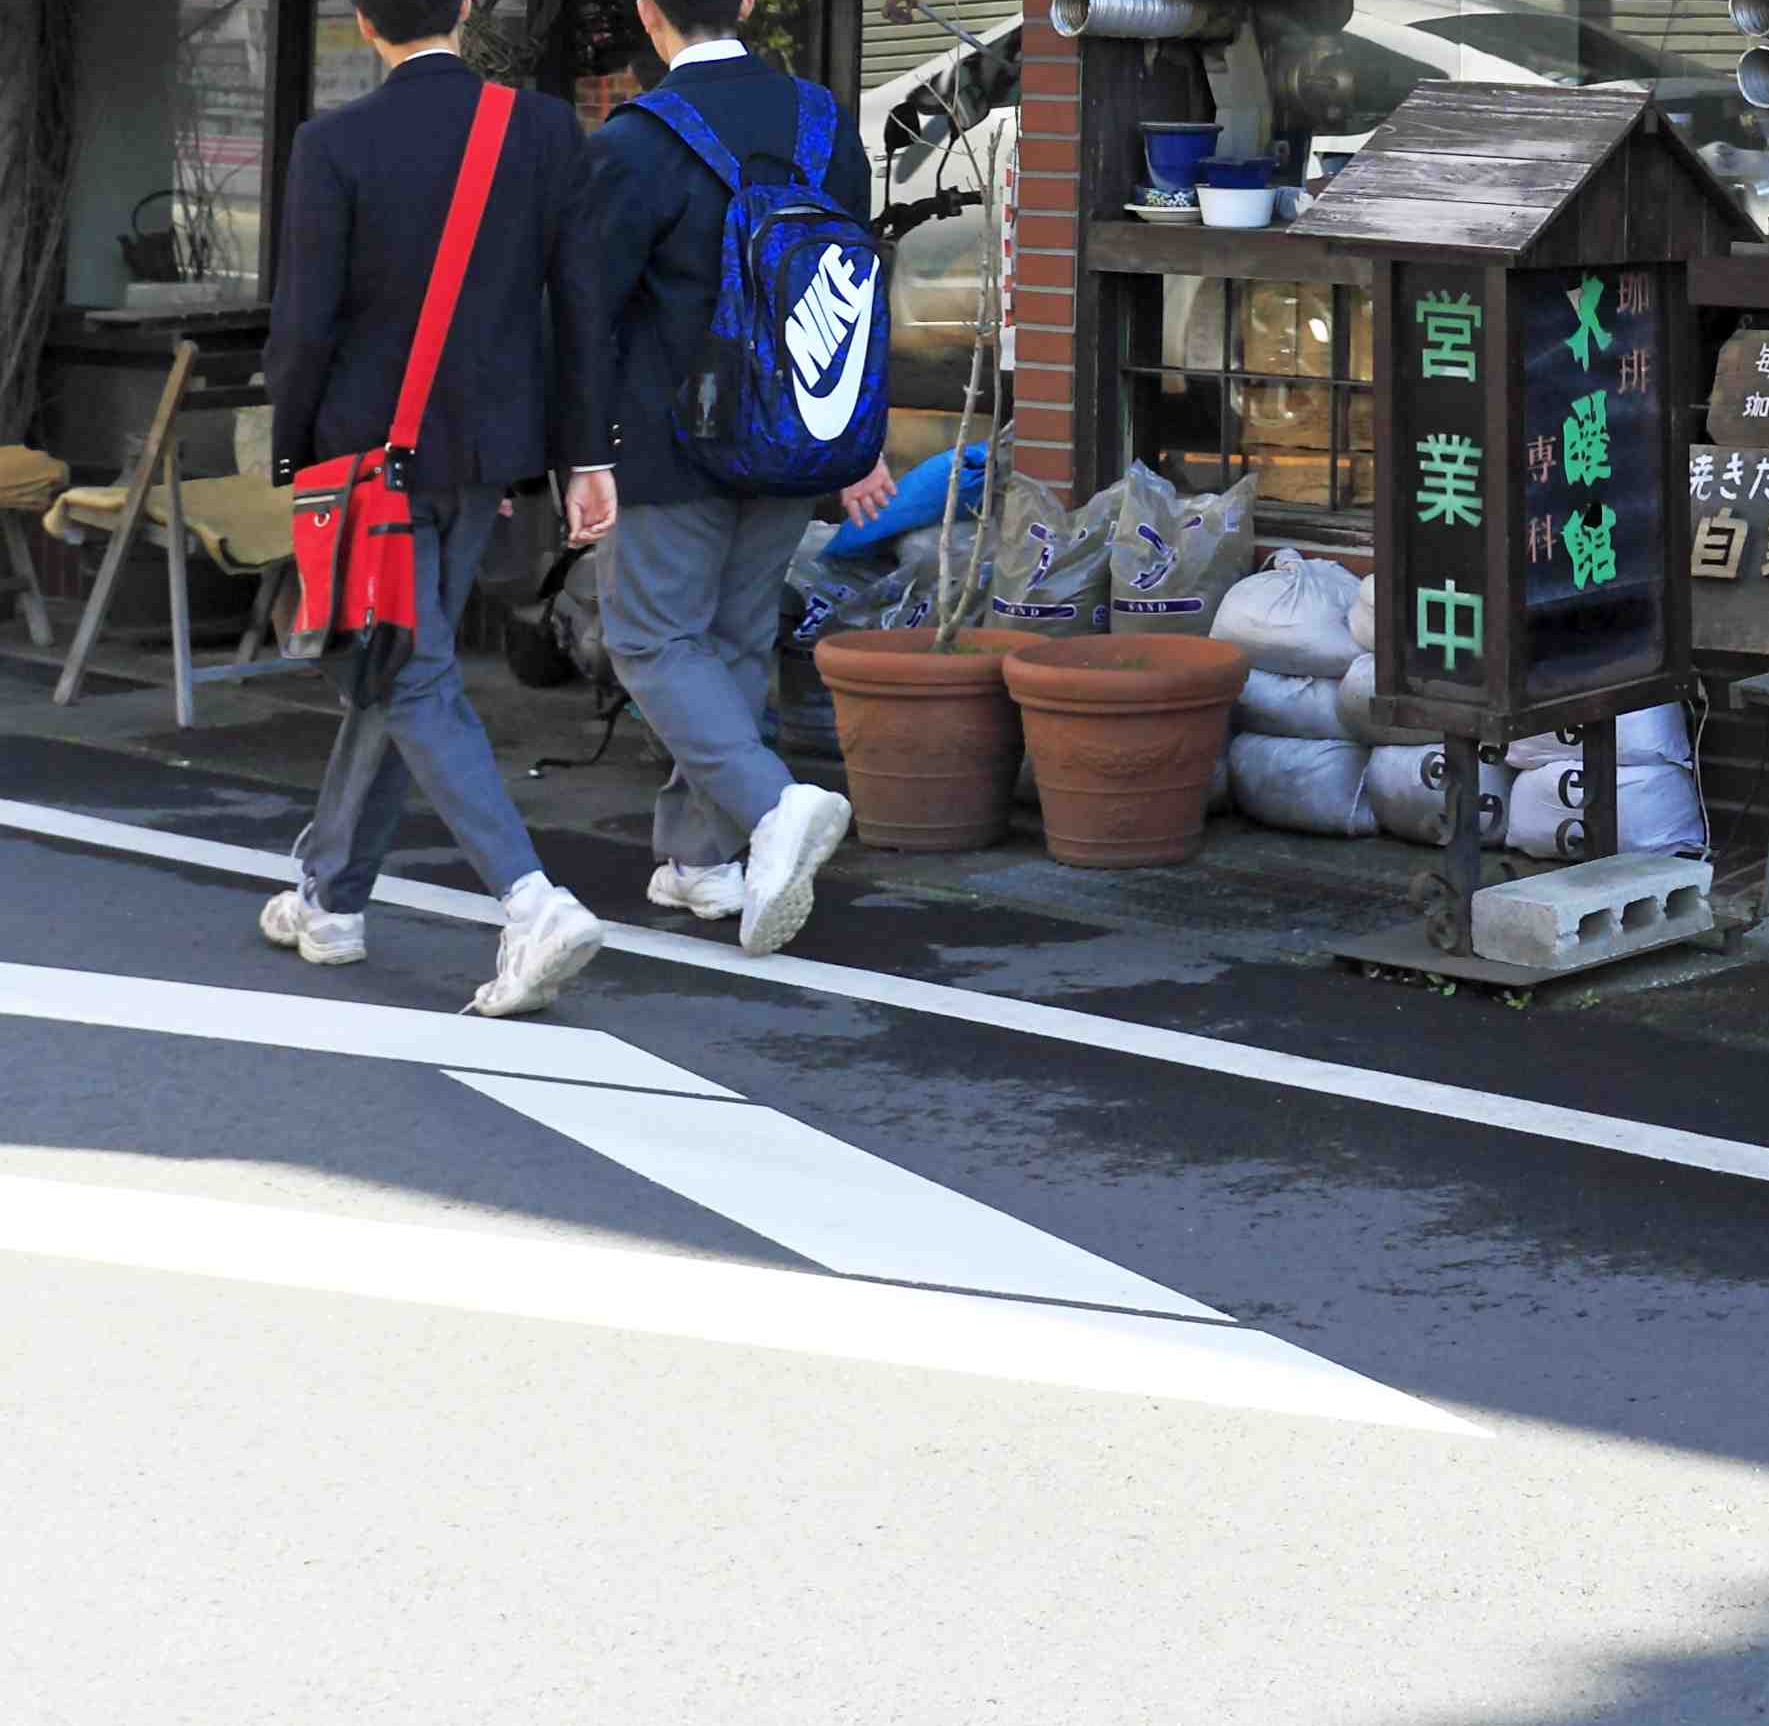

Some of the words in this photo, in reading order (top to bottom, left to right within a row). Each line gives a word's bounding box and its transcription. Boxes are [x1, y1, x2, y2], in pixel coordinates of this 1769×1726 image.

[785, 243, 866, 390] NIKE
[1616, 273, 1651, 395] 珈琲
[1414, 288, 1485, 672] 営業中
